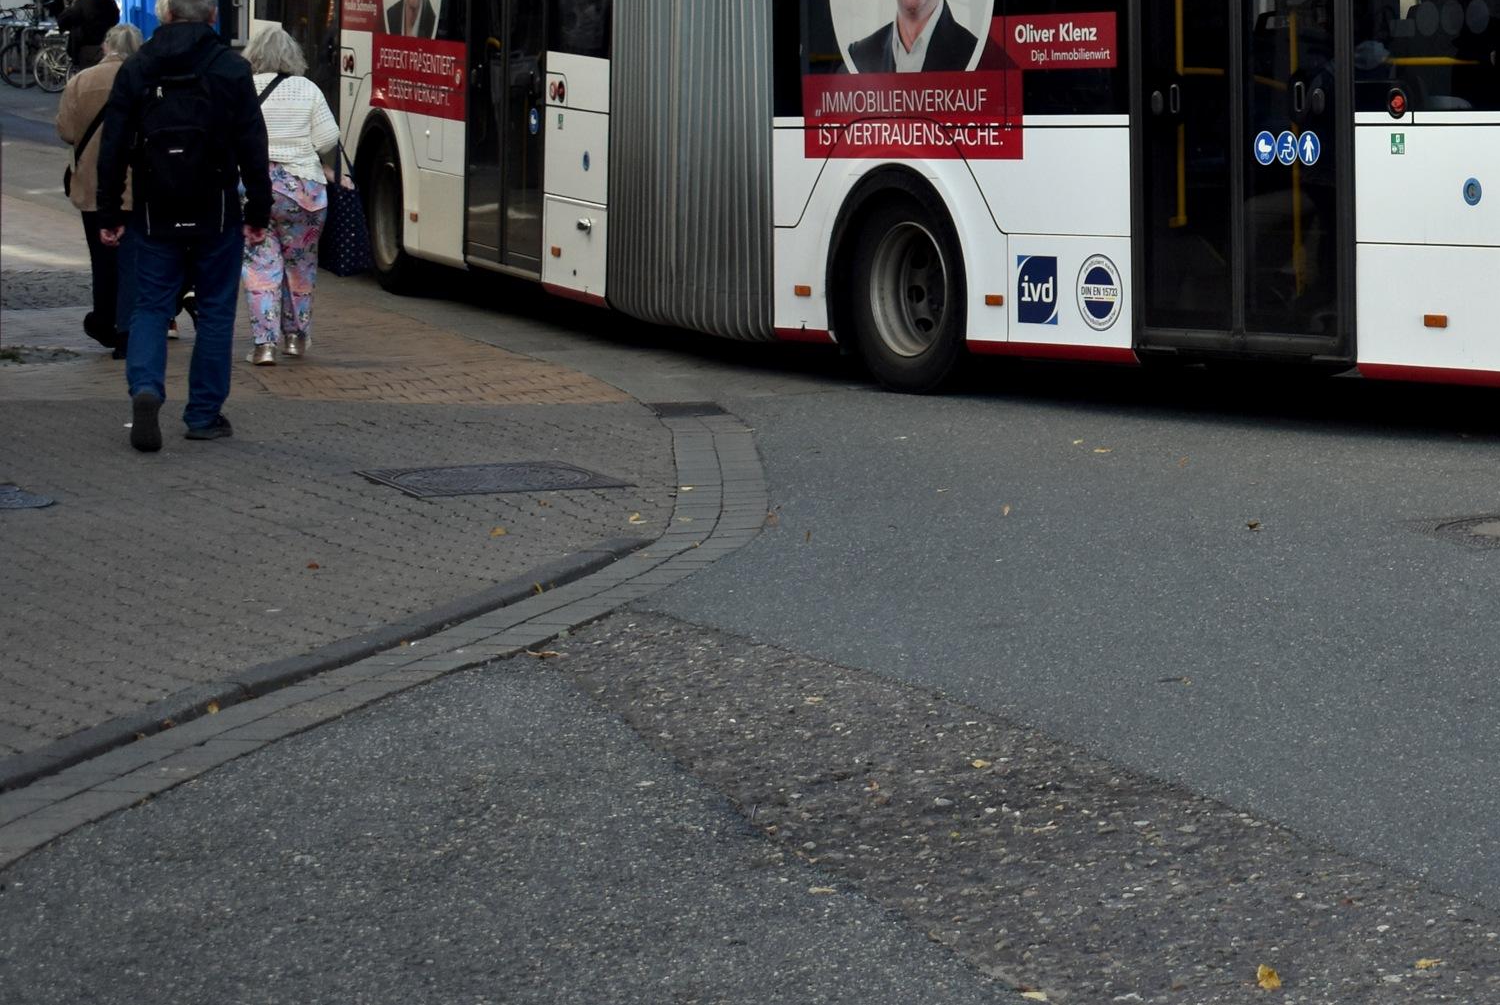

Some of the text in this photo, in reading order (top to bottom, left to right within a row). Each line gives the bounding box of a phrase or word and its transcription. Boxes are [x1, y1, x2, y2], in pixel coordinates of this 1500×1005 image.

[1014, 21, 1098, 44] Oliver Klenz
[1030, 47, 1111, 64] Dipl. Immobilienwirt
[818, 123, 841, 146] IST
[1020, 275, 1054, 303] ivd
[1080, 285, 1092, 296] DIN
[1093, 286, 1102, 297] EN
